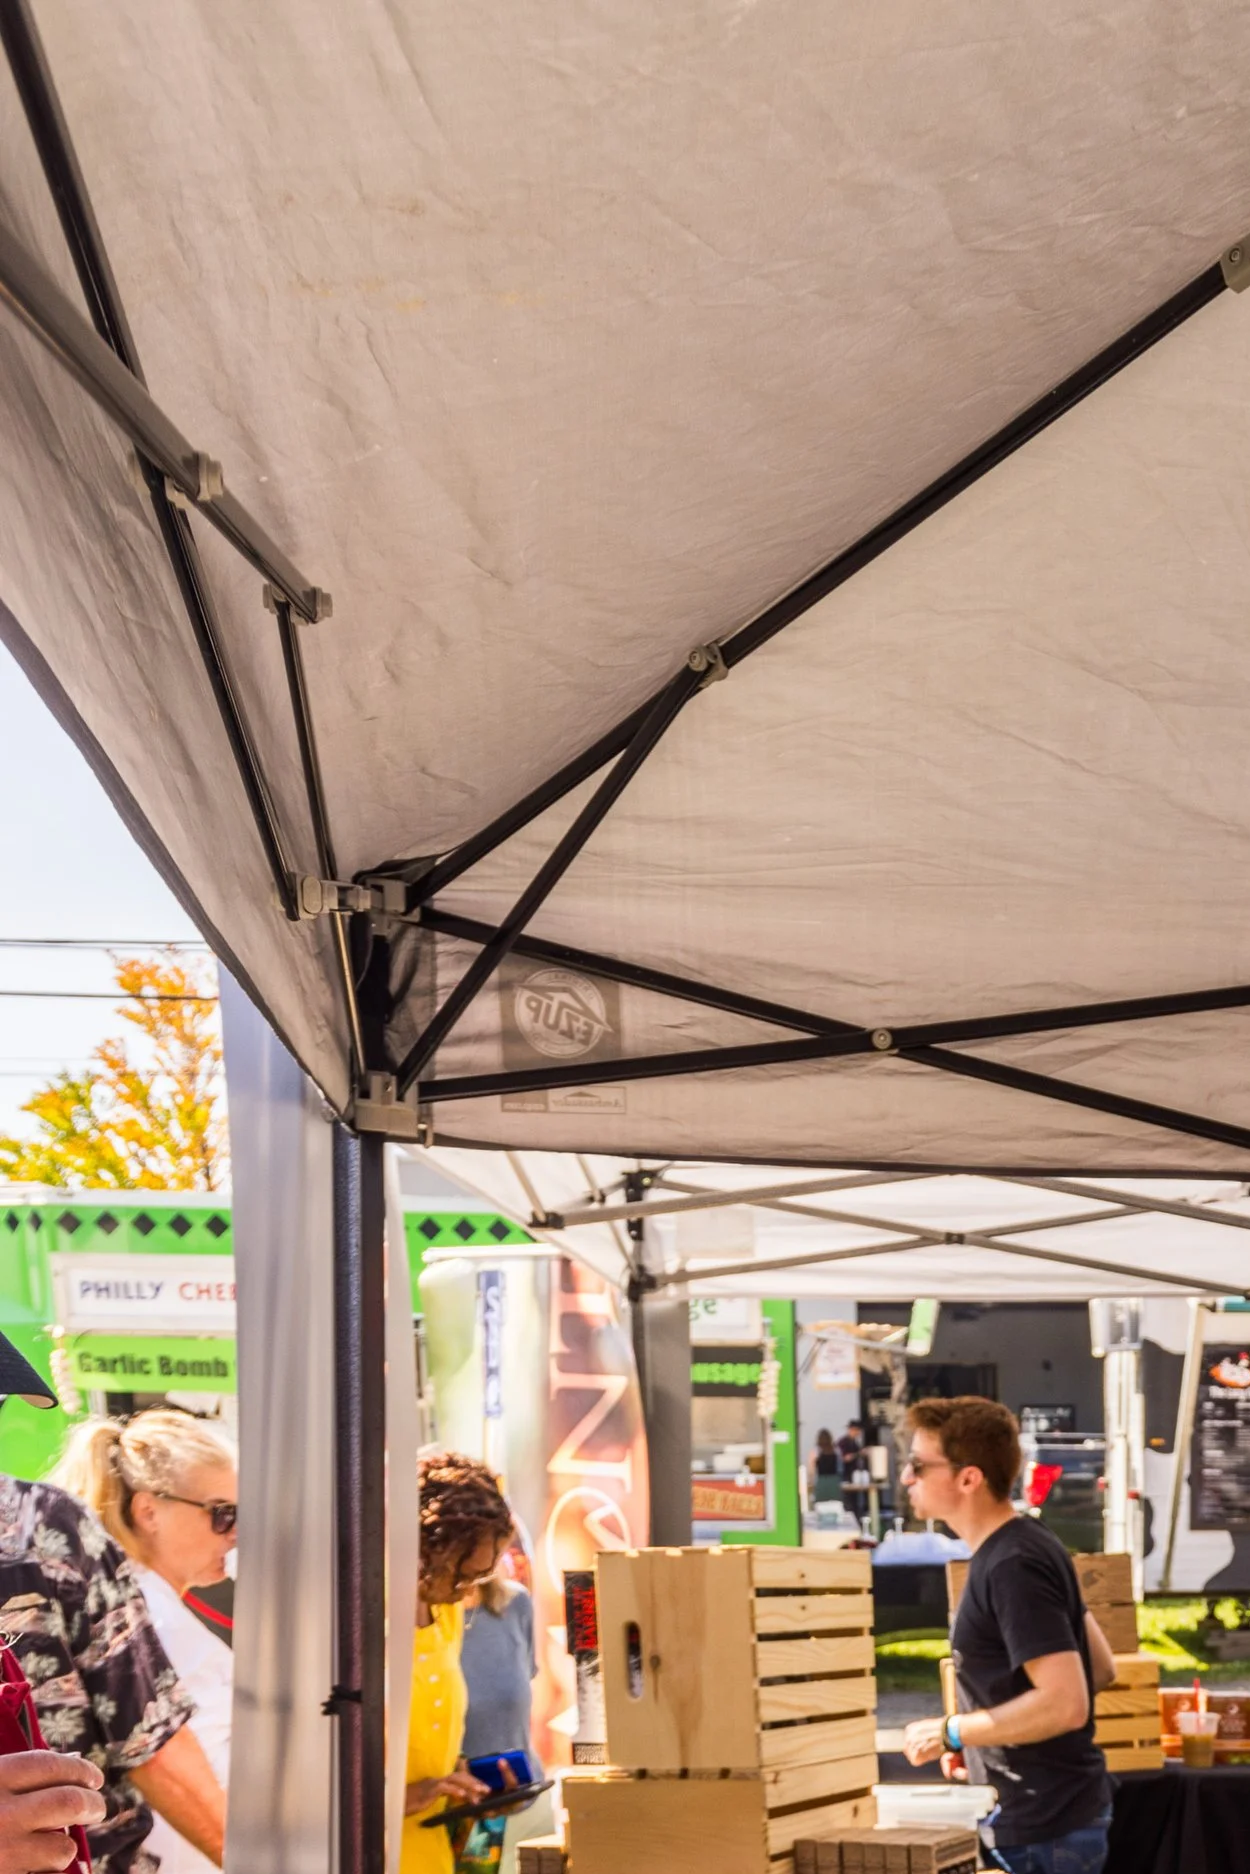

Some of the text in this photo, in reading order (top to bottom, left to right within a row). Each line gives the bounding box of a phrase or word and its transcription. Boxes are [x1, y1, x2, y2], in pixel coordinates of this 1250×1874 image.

[79, 1280, 164, 1300] PHILLY
[78, 1352, 228, 1378] Garlic Bomb
